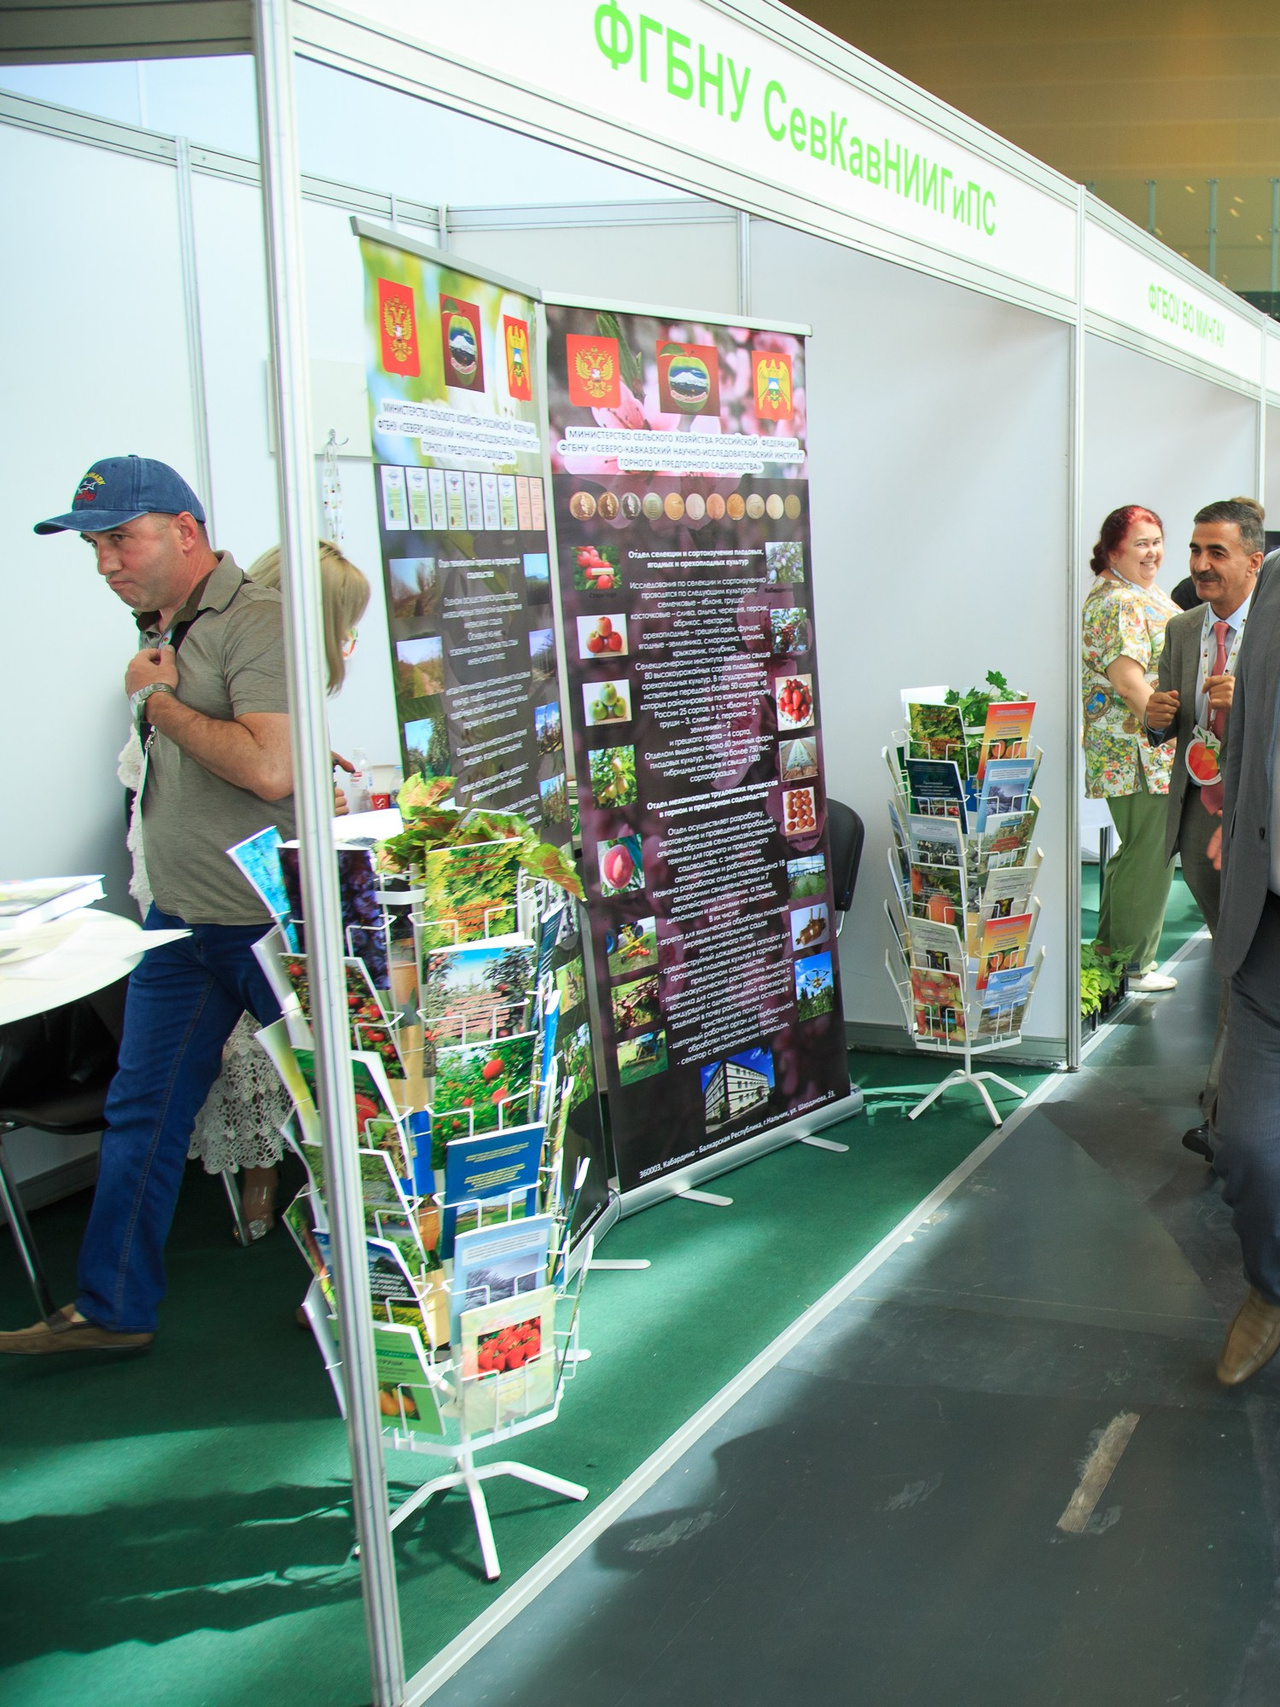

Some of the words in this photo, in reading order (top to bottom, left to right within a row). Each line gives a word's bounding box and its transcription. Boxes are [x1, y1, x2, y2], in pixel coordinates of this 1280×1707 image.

[594, 0, 751, 123] ФГБНУ
[763, 80, 996, 237] СевКавНИИГиПС
[1149, 283, 1180, 326] ФГБОУ
[1182, 301, 1194, 334] ВО
[568, 430, 630, 440] МИНИСТЕРСТВО
[633, 433, 673, 442] СЕЛЬСКОГО
[675, 434, 712, 443] ХОЗЯЙСТВА
[715, 436, 758, 445] РОССИЙСКОЙ
[559, 443, 588, 451] ФГБНУ
[620, 459, 652, 467] ГОРНОГО
[661, 460, 709, 468] ПРЕДГОРНОГО
[628, 550, 650, 559] Отдел
[647, 561, 674, 569] ягодных
[629, 580, 676, 590] Исследования
[686, 579, 716, 587] селекции
[693, 656, 722, 665] института
[751, 651, 770, 659] свыше
[711, 665, 731, 673] сортов
[711, 682, 729, 692] более
[640, 702, 666, 711] которых
[654, 709, 678, 719] России
[705, 742, 723, 750] около
[729, 746, 748, 756] более
[727, 757, 747, 766] свыше
[646, 799, 667, 810] Отдел
[747, 779, 778, 791] процессов
[664, 807, 688, 817] горном
[693, 798, 730, 812] предгорном
[731, 790, 768, 804] садоводстве
[667, 825, 687, 836] Отдел
[683, 839, 712, 852] образцов
[692, 852, 702, 860] для
[703, 846, 726, 857] горного
[732, 837, 768, 851] предгорного
[679, 876, 715, 892] разработок
[755, 882, 772, 891] также
[684, 931, 695, 939] для
[732, 910, 763, 925] обработки
[749, 920, 767, 930] садах
[781, 931, 790, 939] для
[703, 958, 730, 972] плодовых
[731, 952, 751, 964] культур
[756, 944, 777, 956] горном
[696, 994, 706, 1003] для
[703, 1022, 729, 1038] рабочий
[730, 1018, 747, 1029] орган
[747, 1014, 757, 1023] для
[698, 1133, 730, 1154] Балкарская
